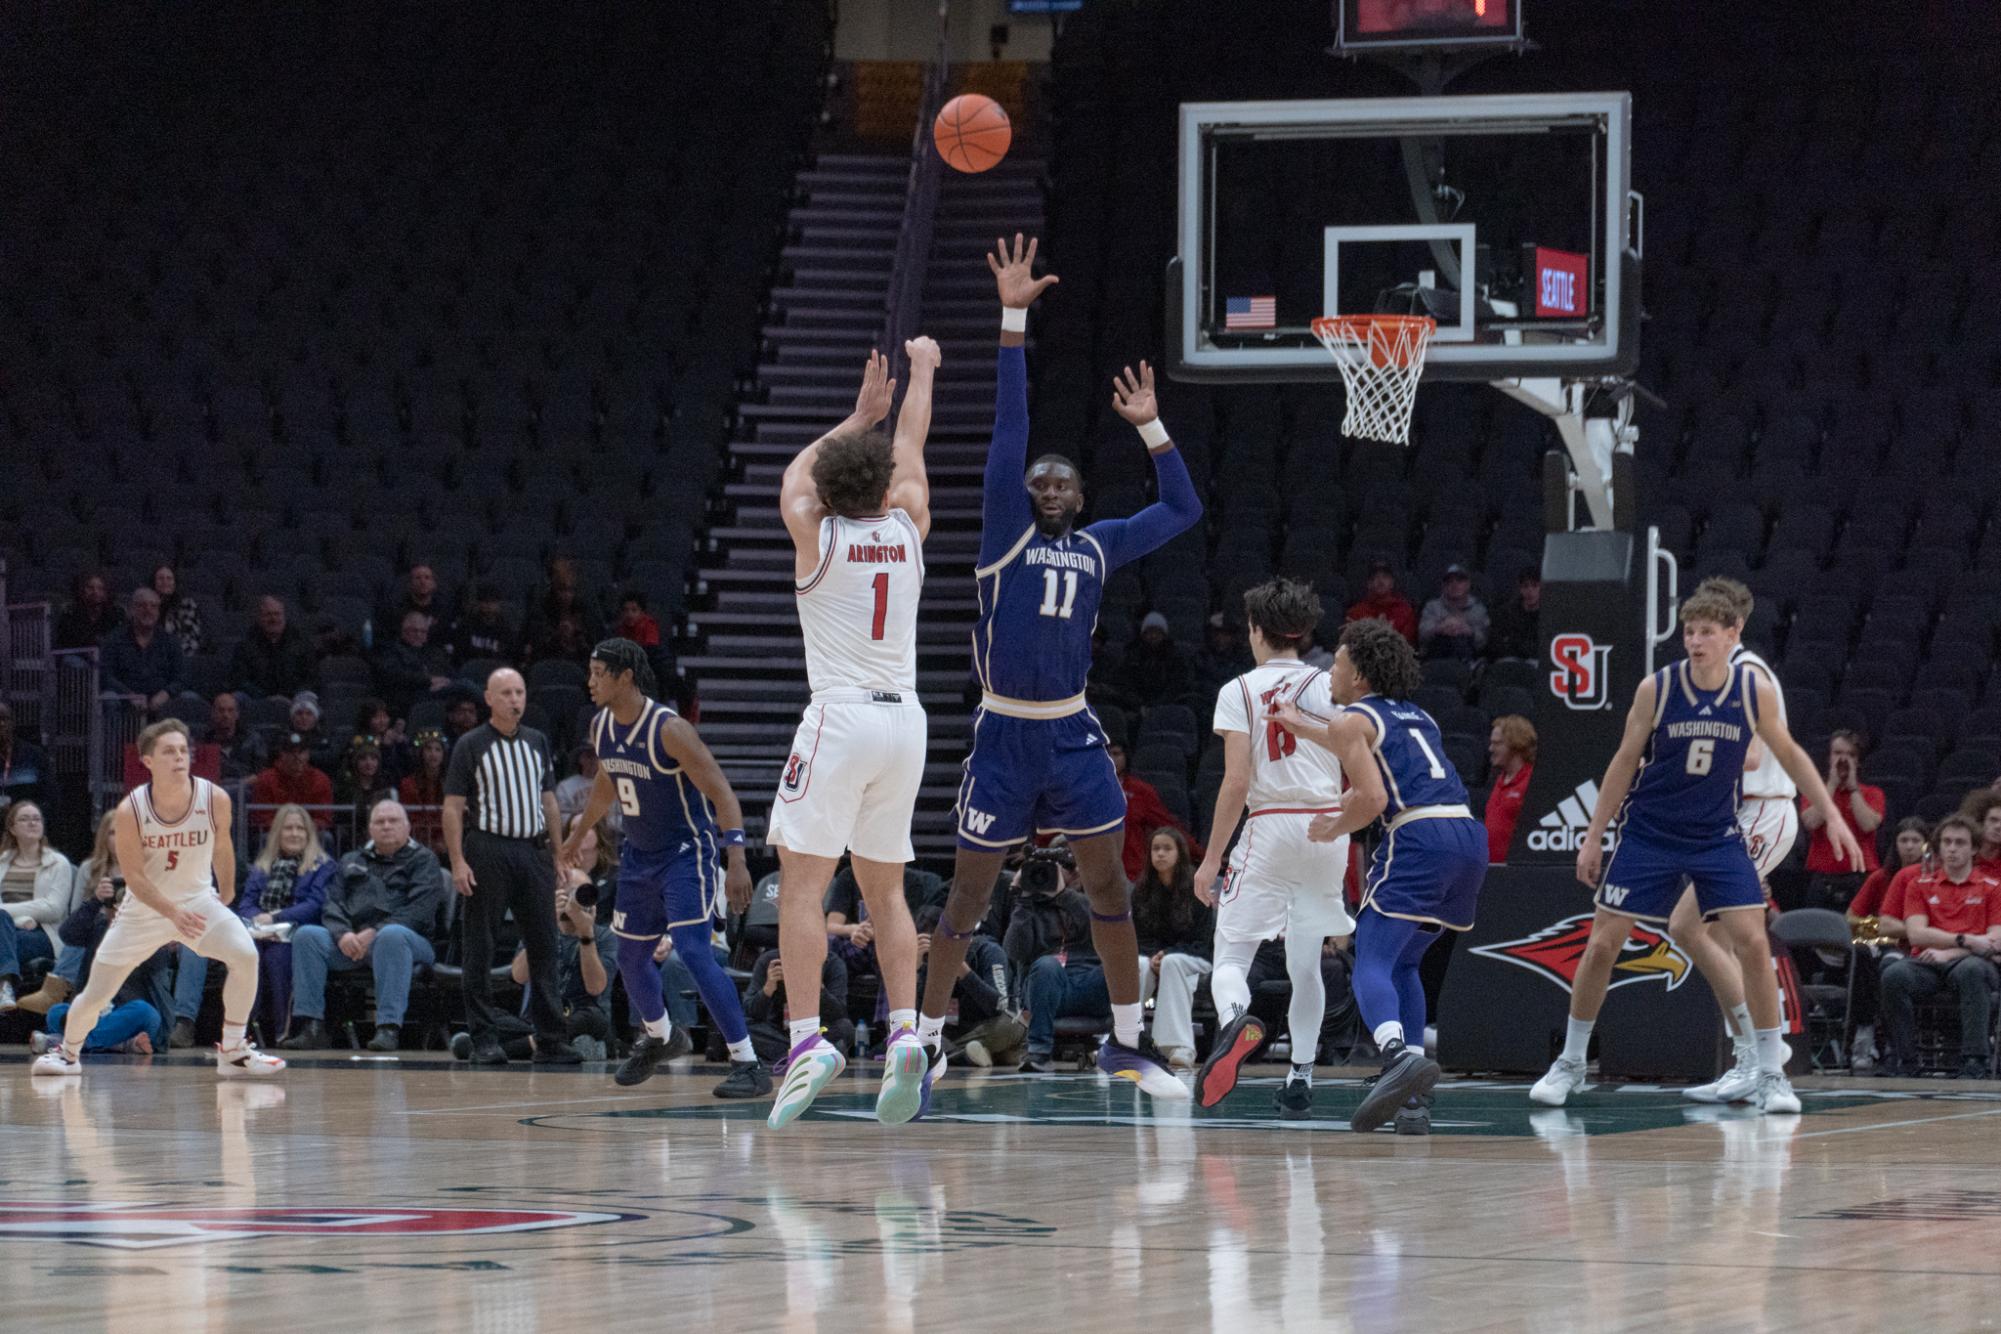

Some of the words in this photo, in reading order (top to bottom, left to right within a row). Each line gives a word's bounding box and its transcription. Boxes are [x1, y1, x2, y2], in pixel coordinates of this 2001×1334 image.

[847, 543, 907, 563] ARINGTON
[1025, 546, 1096, 577] WASHINGTON
[871, 573, 889, 640] 1
[1039, 567, 1078, 618] 11
[1667, 720, 1741, 743] WASHINGTON
[1408, 728, 1446, 778] 1
[1685, 739, 1715, 776] 6
[616, 777, 640, 816] 9
[967, 807, 996, 835] W
[1527, 824, 1616, 852] adia
[164, 850, 179, 871] 5
[1605, 883, 1630, 906] W
